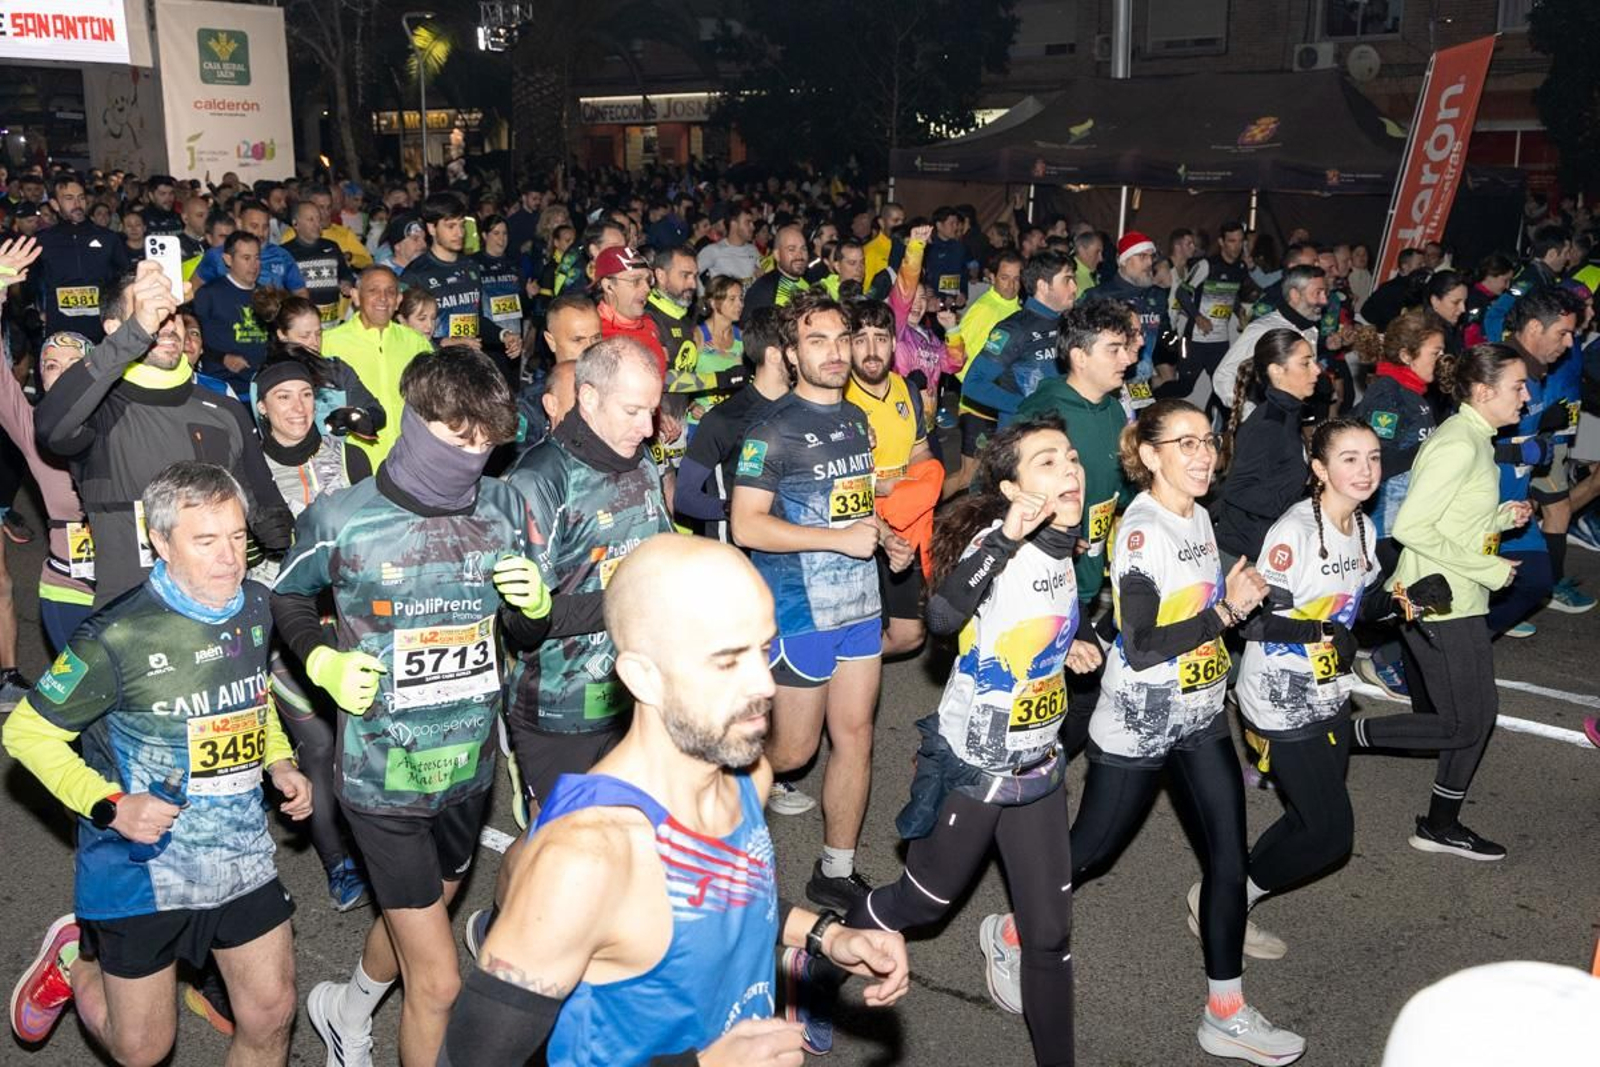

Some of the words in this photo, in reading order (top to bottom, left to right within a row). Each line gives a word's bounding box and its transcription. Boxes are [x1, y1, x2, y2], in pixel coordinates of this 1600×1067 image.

[11, 13, 50, 38] SAN
[61, 295, 97, 306] 4381
[813, 459, 847, 480] SAN
[836, 490, 874, 514] 3348
[968, 554, 996, 588] KIPRUN
[405, 640, 489, 677] 5713
[151, 691, 210, 717] SAN
[1017, 687, 1065, 723] 3667
[212, 718, 230, 733] 42
[199, 729, 266, 768] 3456
